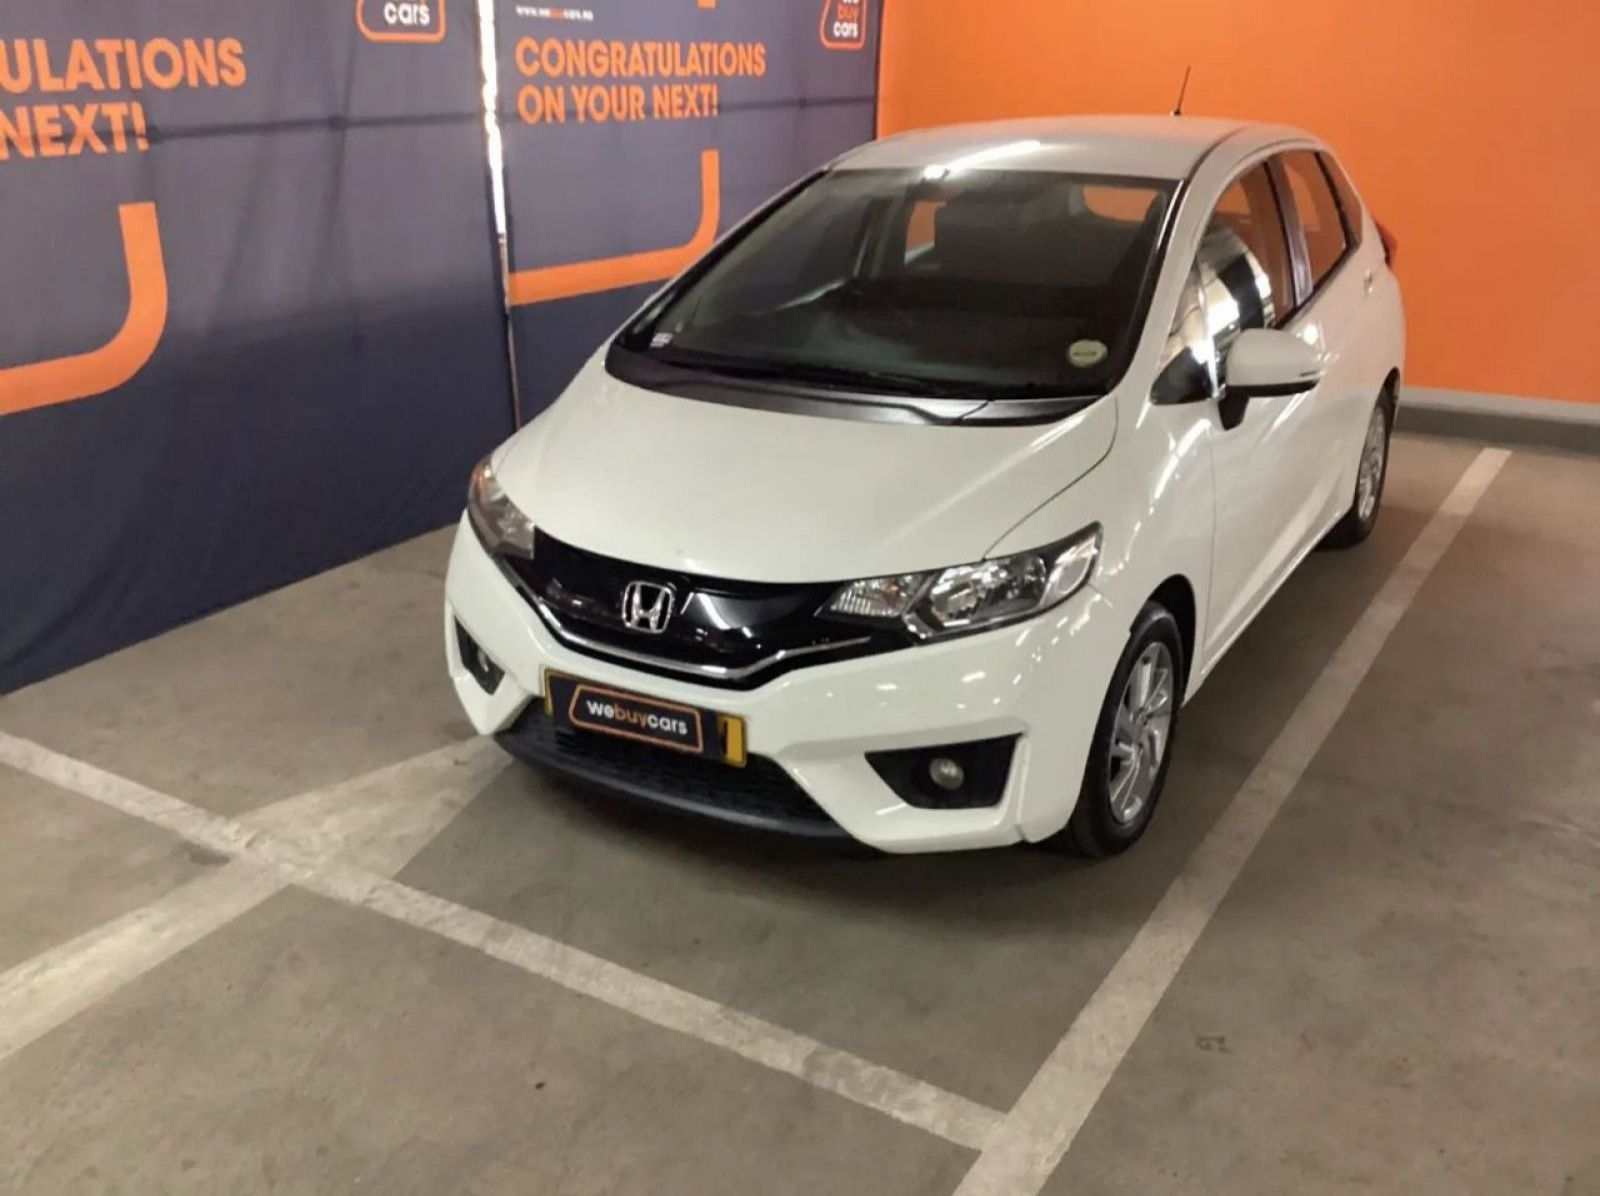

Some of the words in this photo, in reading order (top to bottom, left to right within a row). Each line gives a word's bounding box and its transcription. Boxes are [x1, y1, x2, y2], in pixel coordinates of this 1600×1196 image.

[384, 2, 431, 27] cars
[833, 21, 859, 39] cars
[0, 37, 247, 93] ULATIONS
[514, 36, 767, 78] CONGRATULATIONS
[516, 83, 566, 125] ON
[570, 83, 646, 122] YOUR
[651, 82, 719, 119] NEXT!
[0, 101, 149, 160] NEXT!
[585, 699, 688, 736] webuycars
